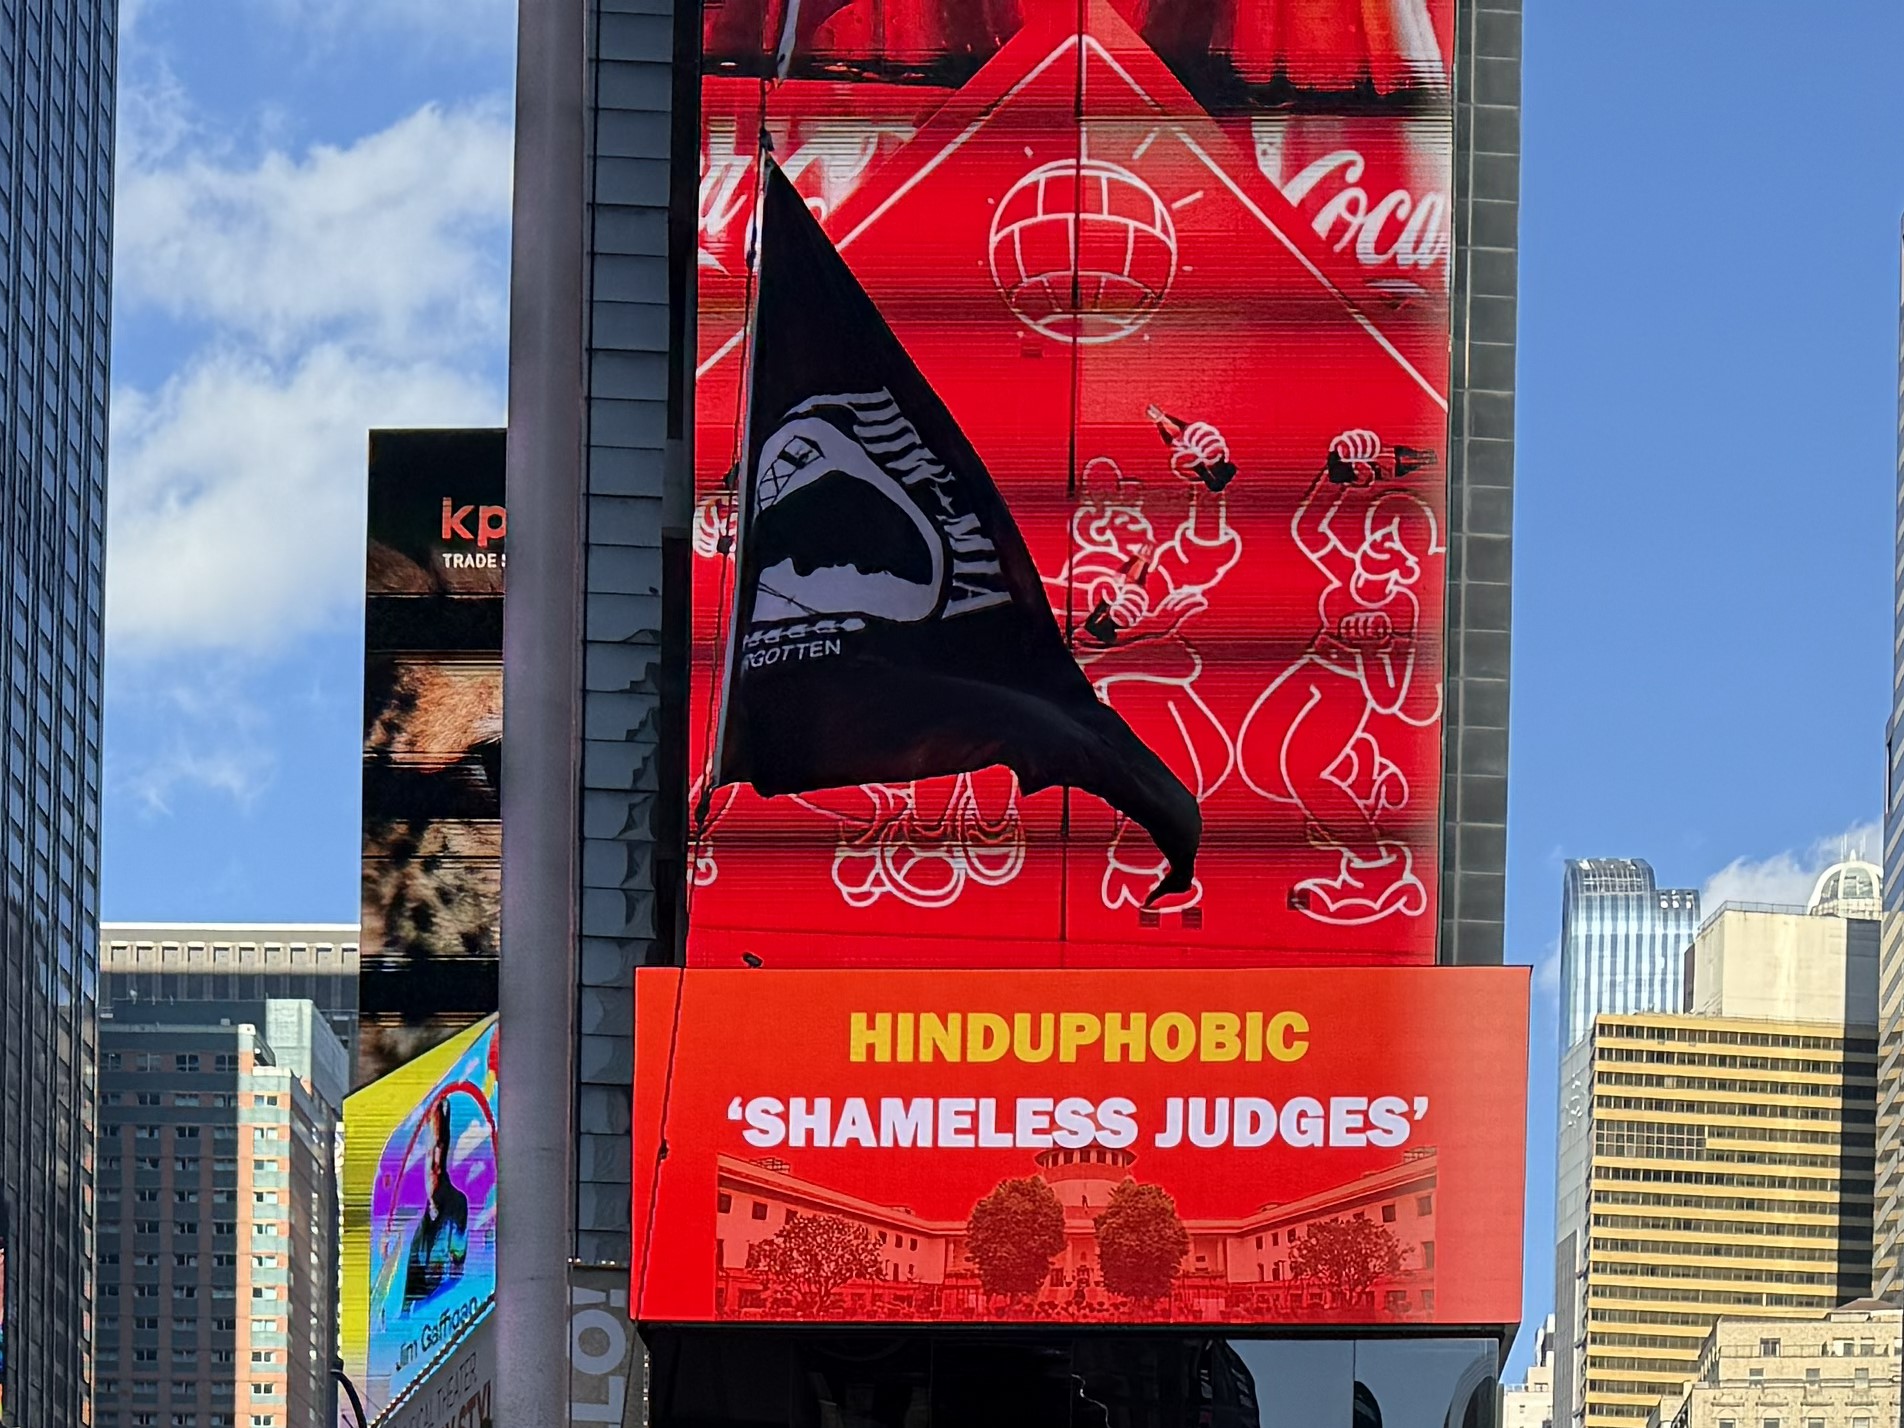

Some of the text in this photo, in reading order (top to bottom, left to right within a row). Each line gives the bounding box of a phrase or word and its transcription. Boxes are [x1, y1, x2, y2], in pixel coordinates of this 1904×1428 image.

[443, 554, 497, 568] TRADE
[848, 1010, 1310, 1065] HINDUPHOBIC
[728, 1095, 1429, 1150] ‘SHAMELESS JUDGES’
